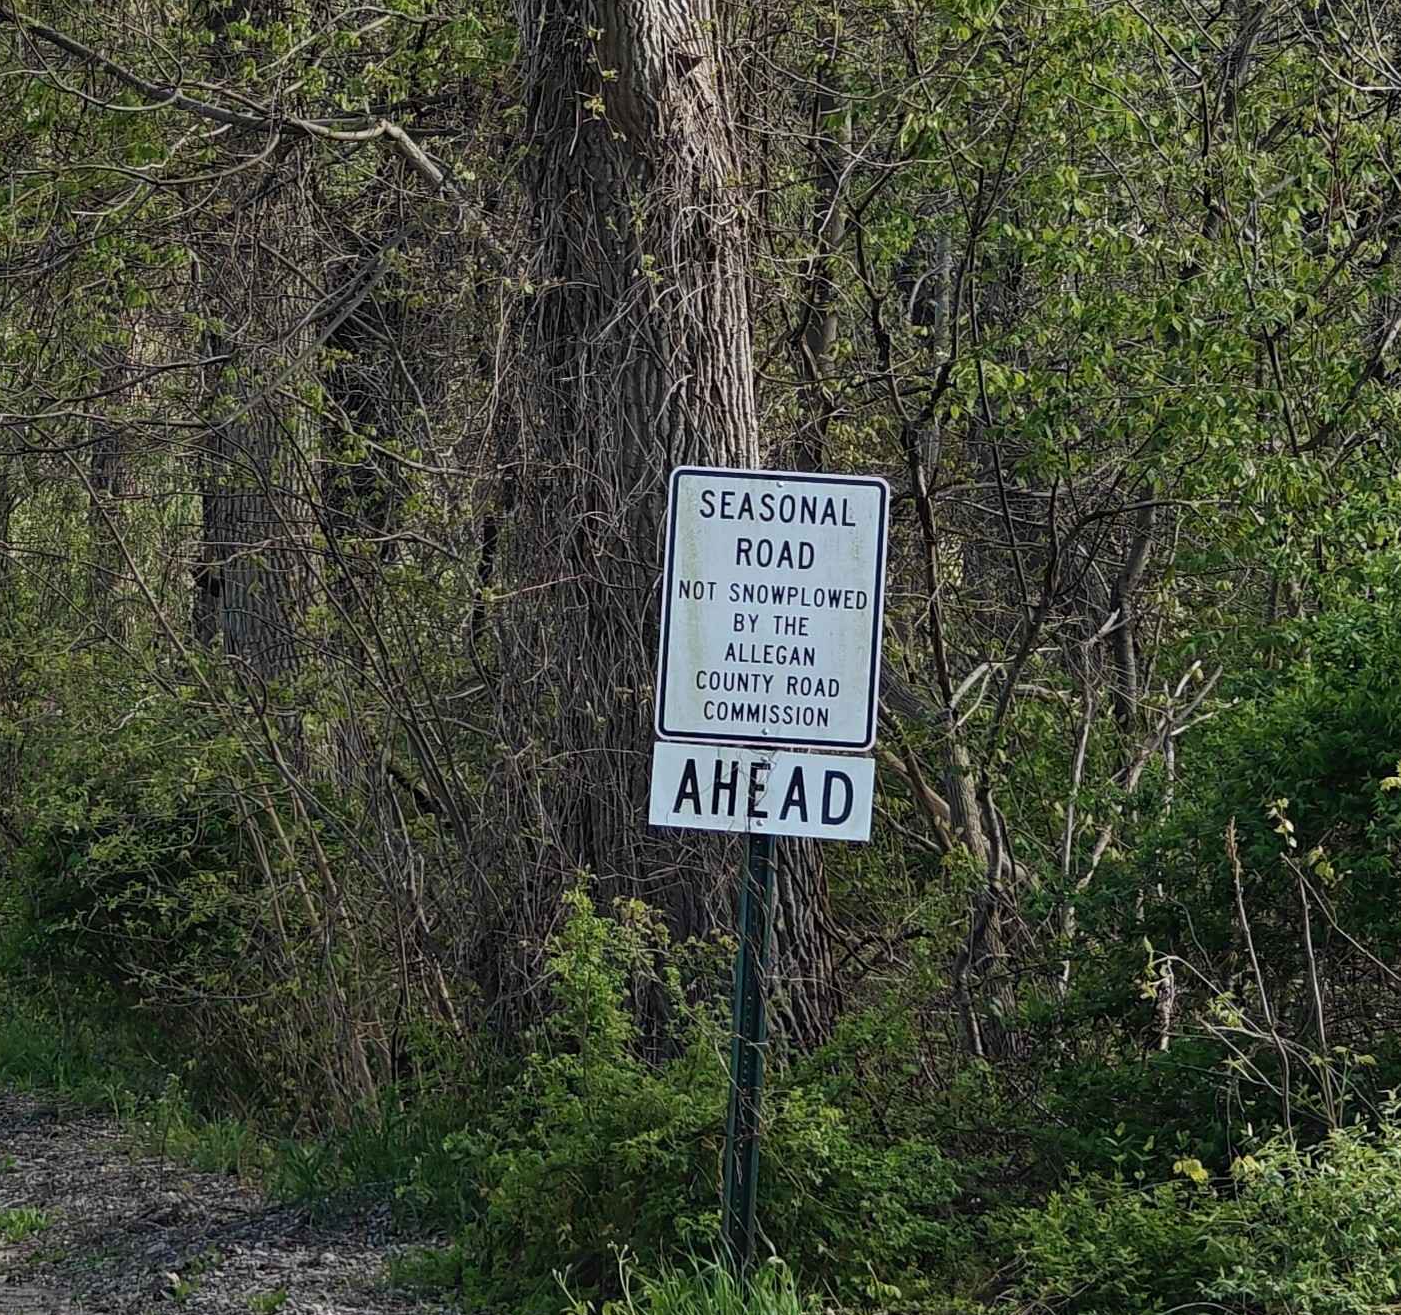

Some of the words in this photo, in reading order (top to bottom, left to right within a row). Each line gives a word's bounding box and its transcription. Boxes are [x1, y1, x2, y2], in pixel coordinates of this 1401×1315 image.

[699, 489, 856, 527] SEASONAL
[736, 537, 815, 570] ROAD
[678, 579, 717, 601] NOT
[729, 582, 868, 610] SNOWPLOWED
[733, 612, 759, 633] BY
[773, 615, 809, 637] THE
[724, 642, 815, 667] ALLEGAN
[696, 670, 774, 694] COUNTY
[786, 675, 840, 698] ROAD
[703, 700, 829, 727] COMMISSION
[672, 758, 854, 827] AHEAD
